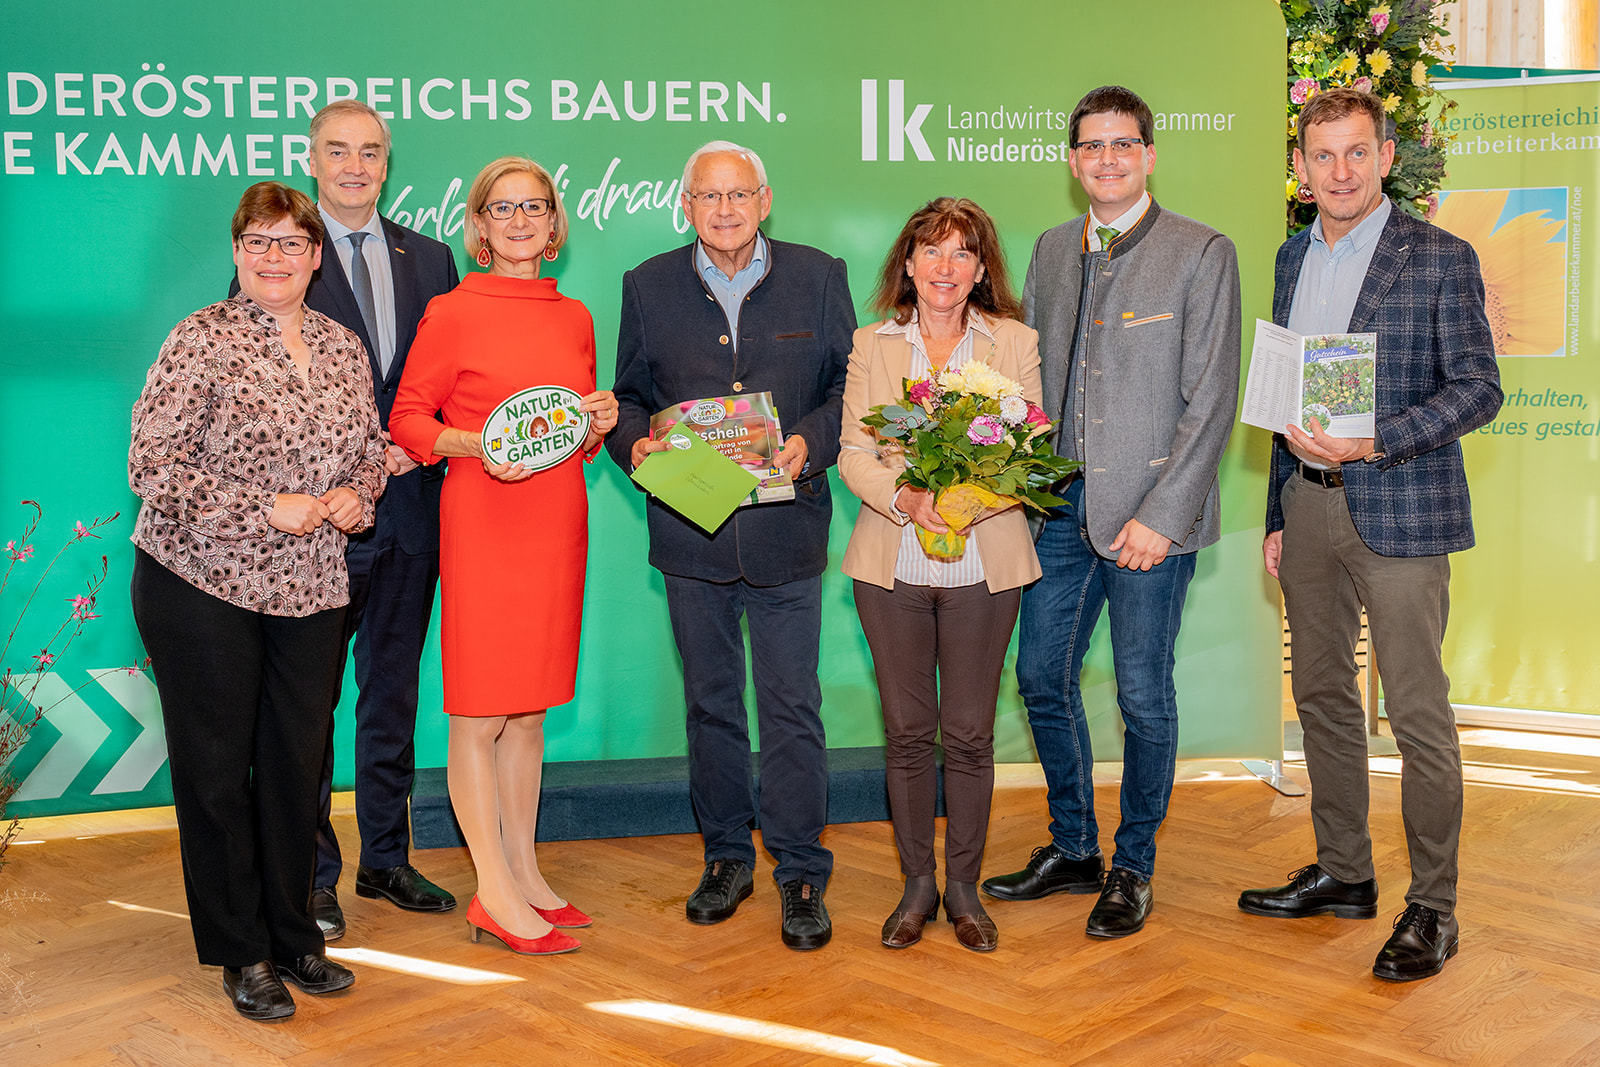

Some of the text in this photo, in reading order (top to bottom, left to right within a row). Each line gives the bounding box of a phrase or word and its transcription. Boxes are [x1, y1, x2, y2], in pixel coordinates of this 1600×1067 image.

[551, 79, 787, 122] BAUERN.
[3, 131, 312, 177] E KAMMER
[947, 137, 1068, 162] Niederöst
[1568, 186, 1582, 356] www.landarbeiterkammer.at/noe
[505, 392, 562, 421] NATUR
[1503, 387, 1588, 410] rhalten,
[1471, 421, 1528, 435] eues
[507, 430, 575, 462] GARTEN
